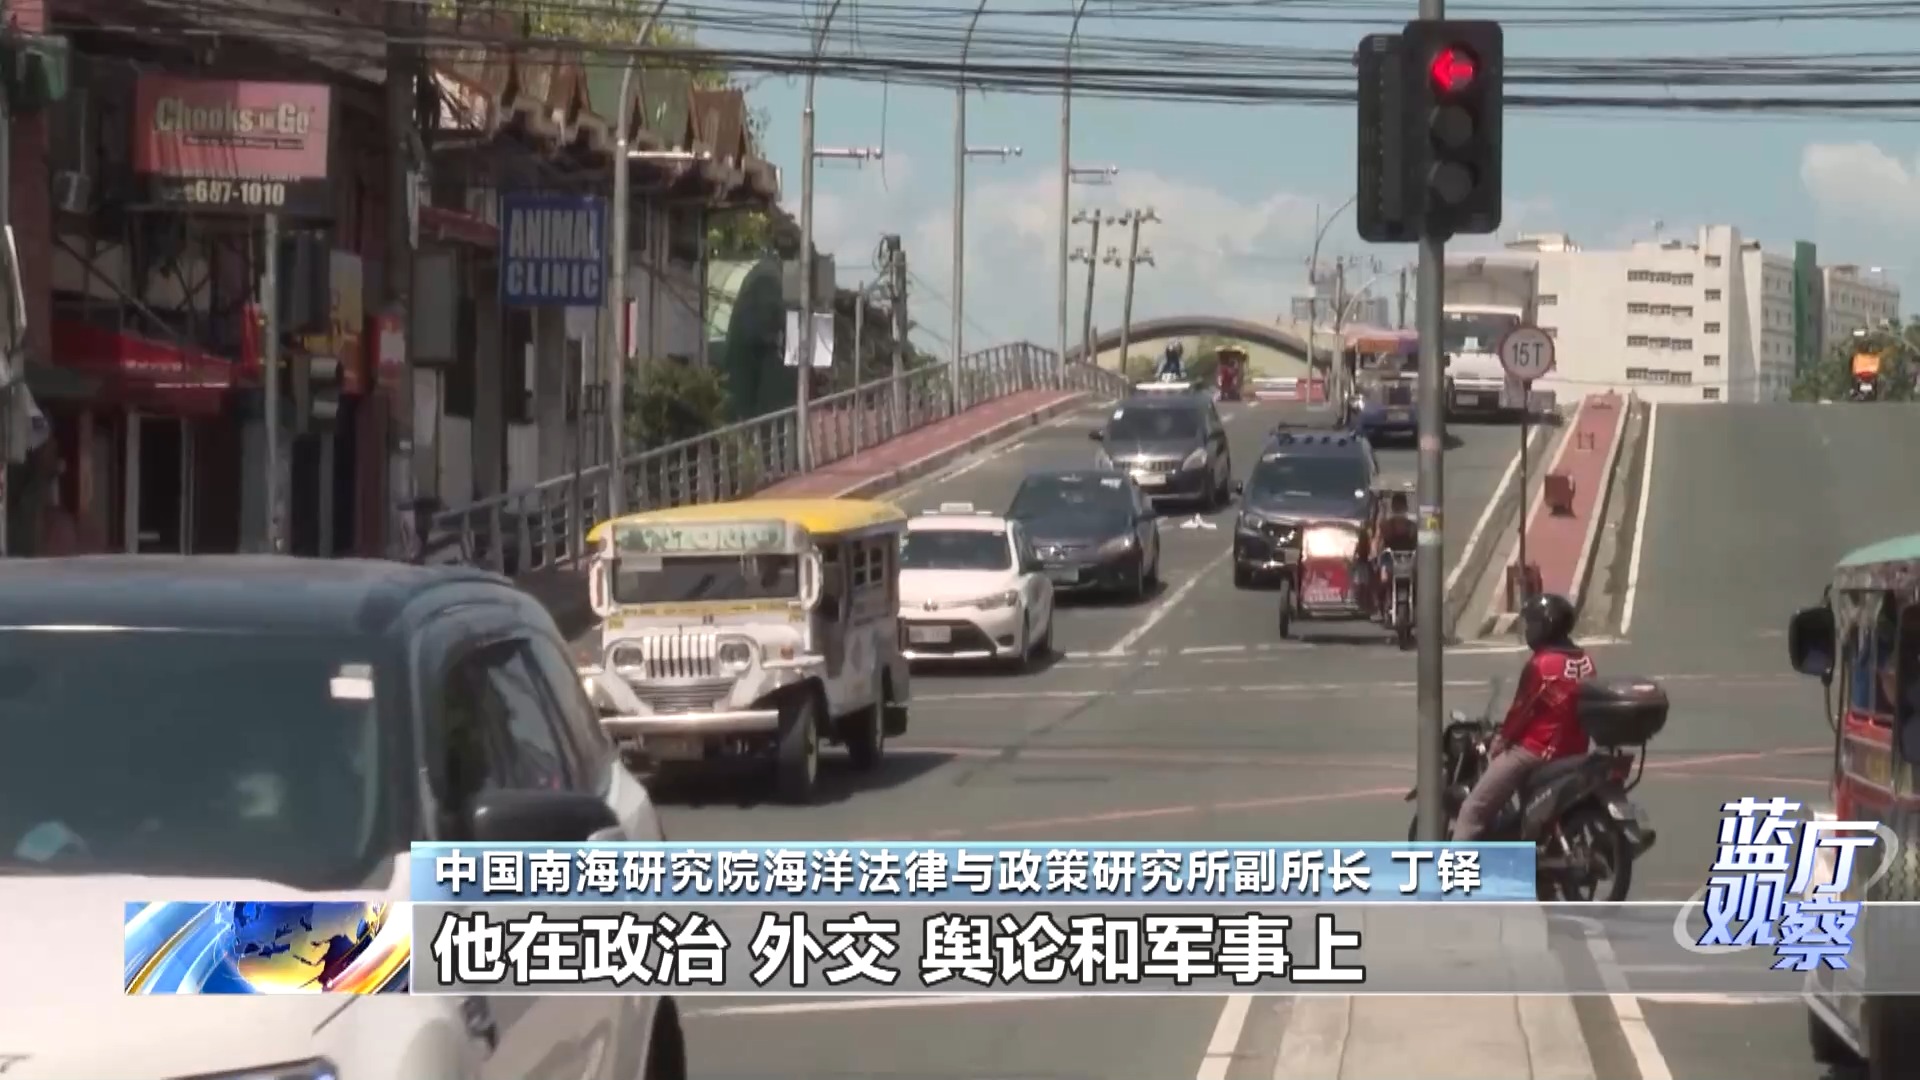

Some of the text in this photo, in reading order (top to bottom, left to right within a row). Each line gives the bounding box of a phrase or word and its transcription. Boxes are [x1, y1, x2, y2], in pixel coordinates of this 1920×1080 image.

[155, 96, 253, 134] Chooks
[277, 103, 310, 134] Go
[508, 208, 601, 261] ANIMAL
[506, 260, 600, 299] CLINIC
